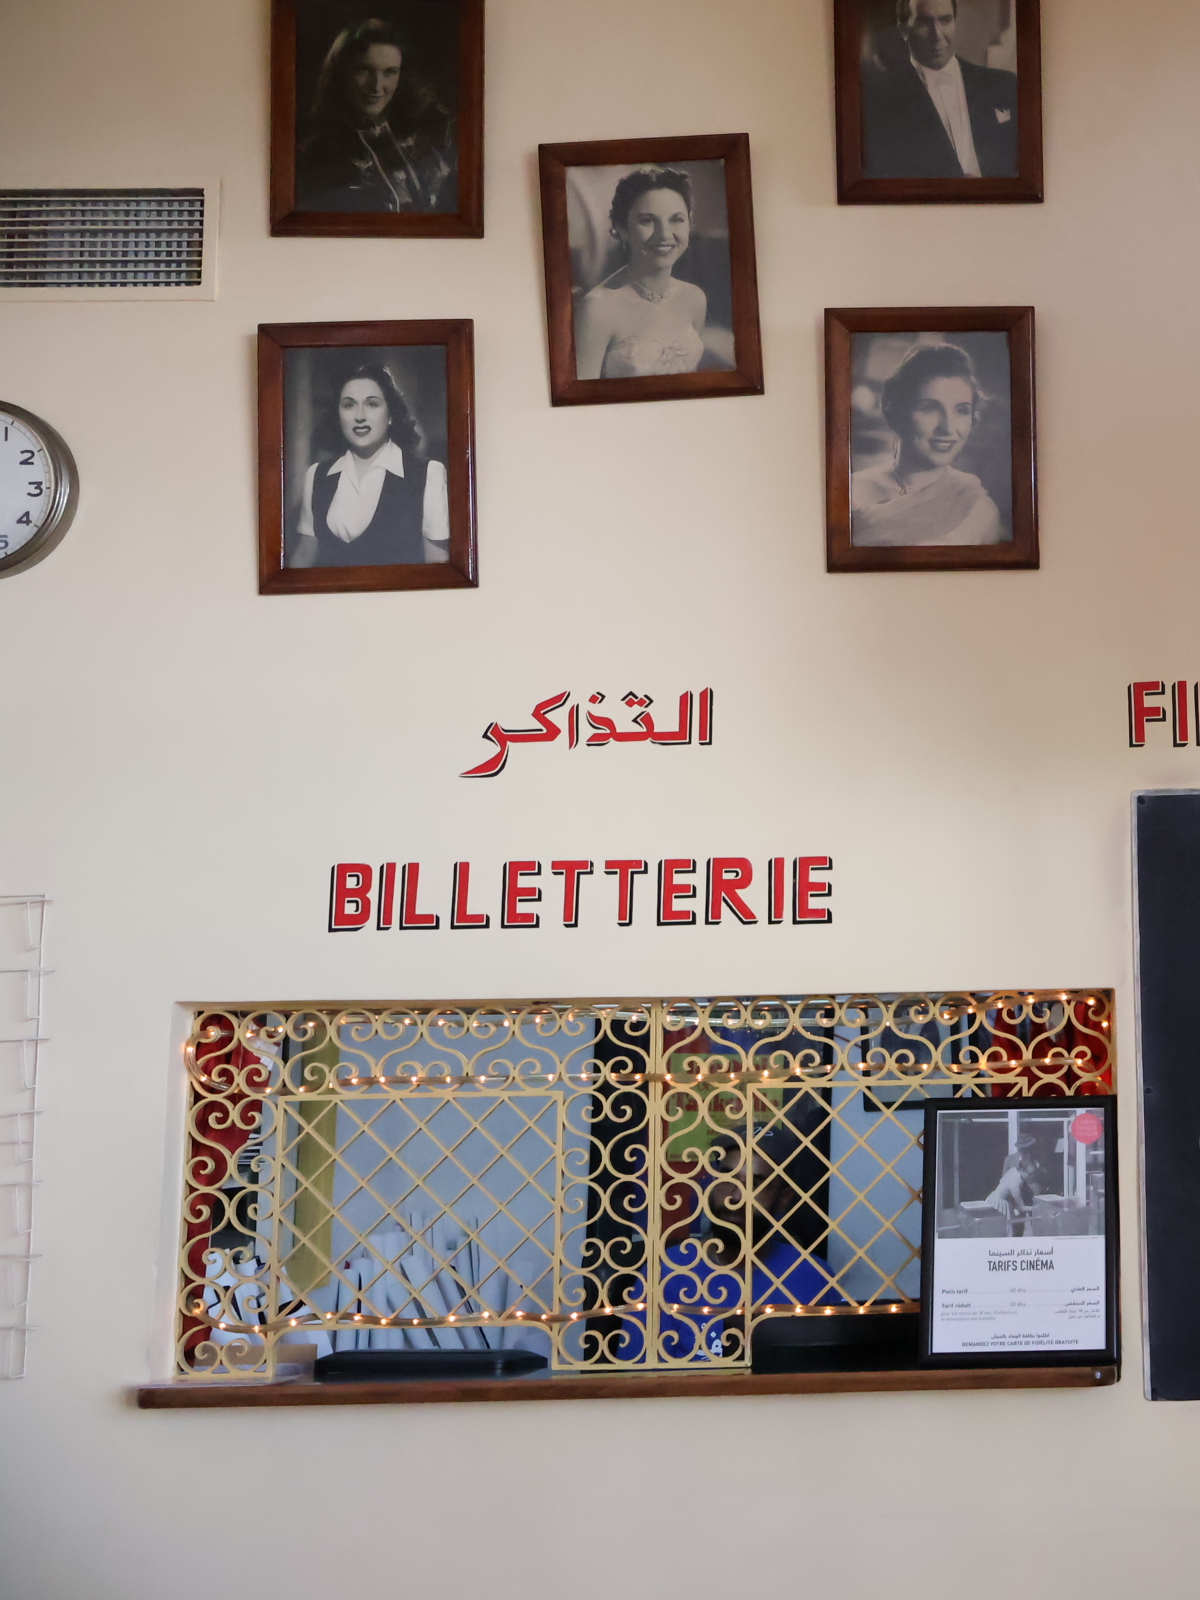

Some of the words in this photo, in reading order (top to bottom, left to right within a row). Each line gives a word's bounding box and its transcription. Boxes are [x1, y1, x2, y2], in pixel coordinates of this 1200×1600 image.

[4, 426, 9, 442] 1
[19, 449, 35, 466] 2
[26, 481, 44, 498] 3
[16, 510, 33, 527] 4
[458, 686, 714, 779] التذاكر
[327, 855, 833, 933] BILLETTERIE
[987, 1259, 1018, 1272] TARIFS
[1020, 1257, 1055, 1271] CINÉMA
